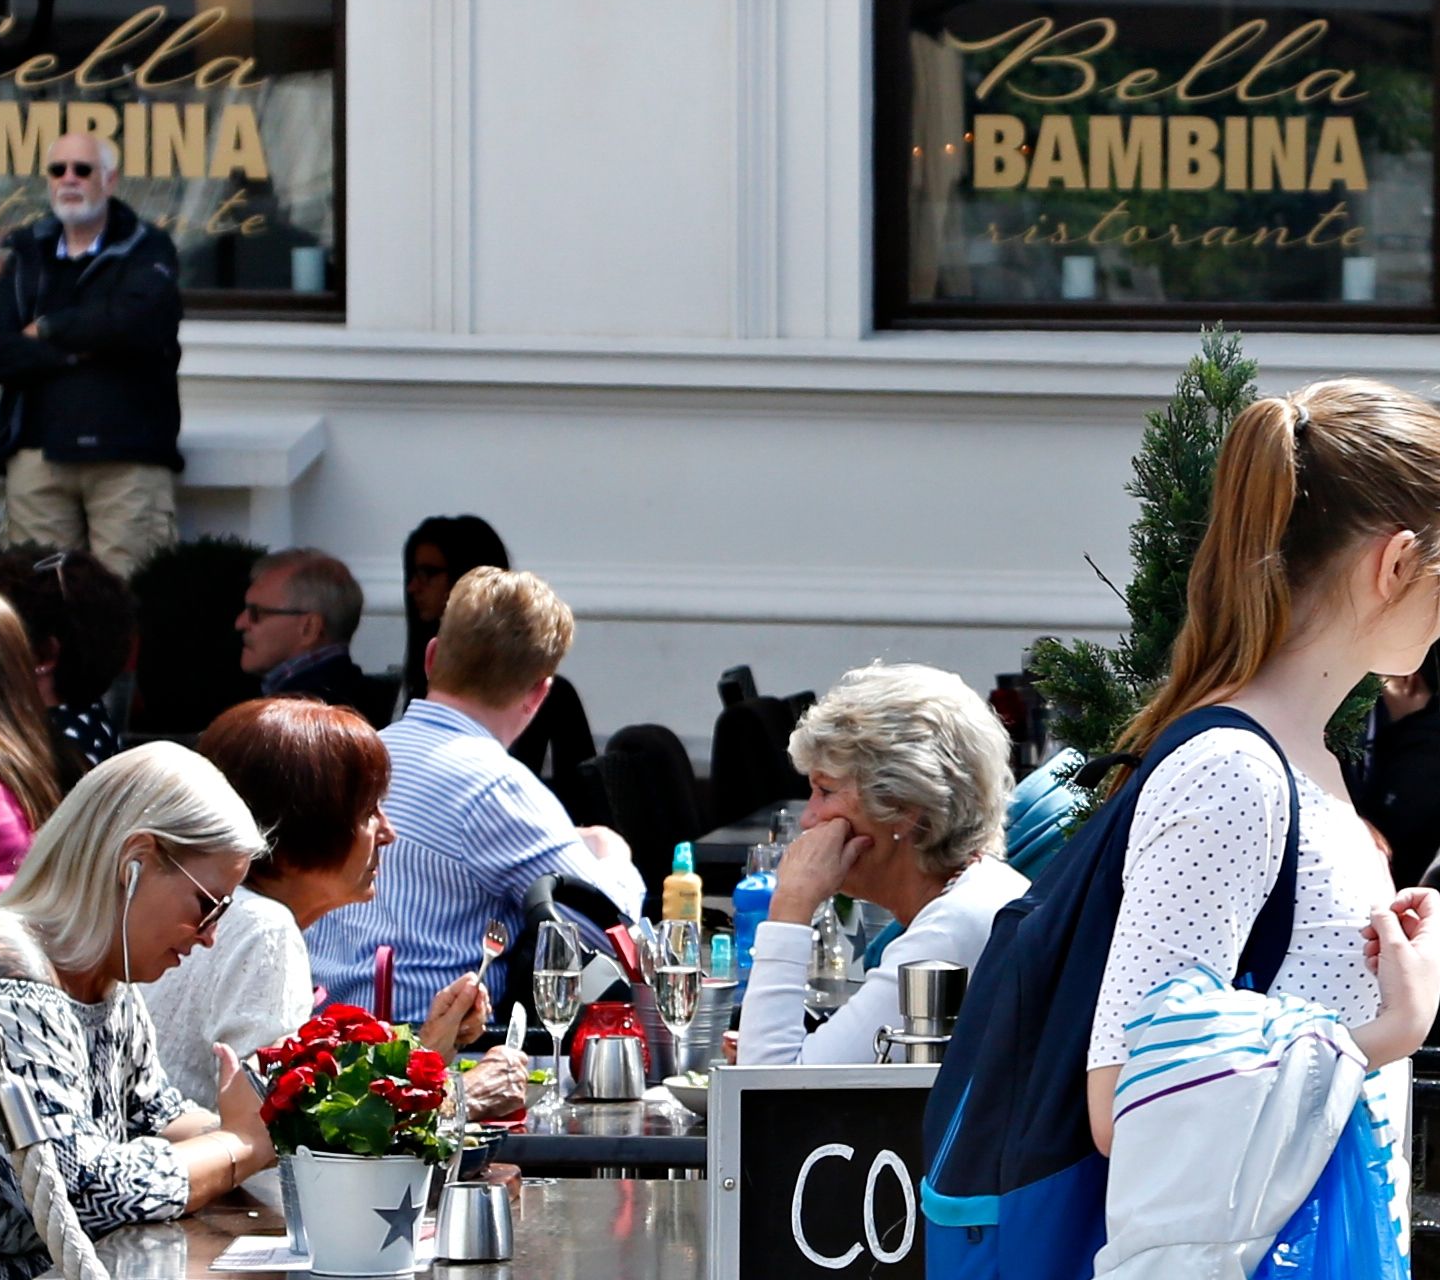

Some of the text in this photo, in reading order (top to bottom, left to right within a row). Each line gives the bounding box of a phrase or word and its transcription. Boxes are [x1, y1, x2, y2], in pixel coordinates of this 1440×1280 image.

[944, 16, 1369, 105] Bella
[973, 114, 1369, 191] BAMBINA
[980, 200, 1367, 251] ristorante
